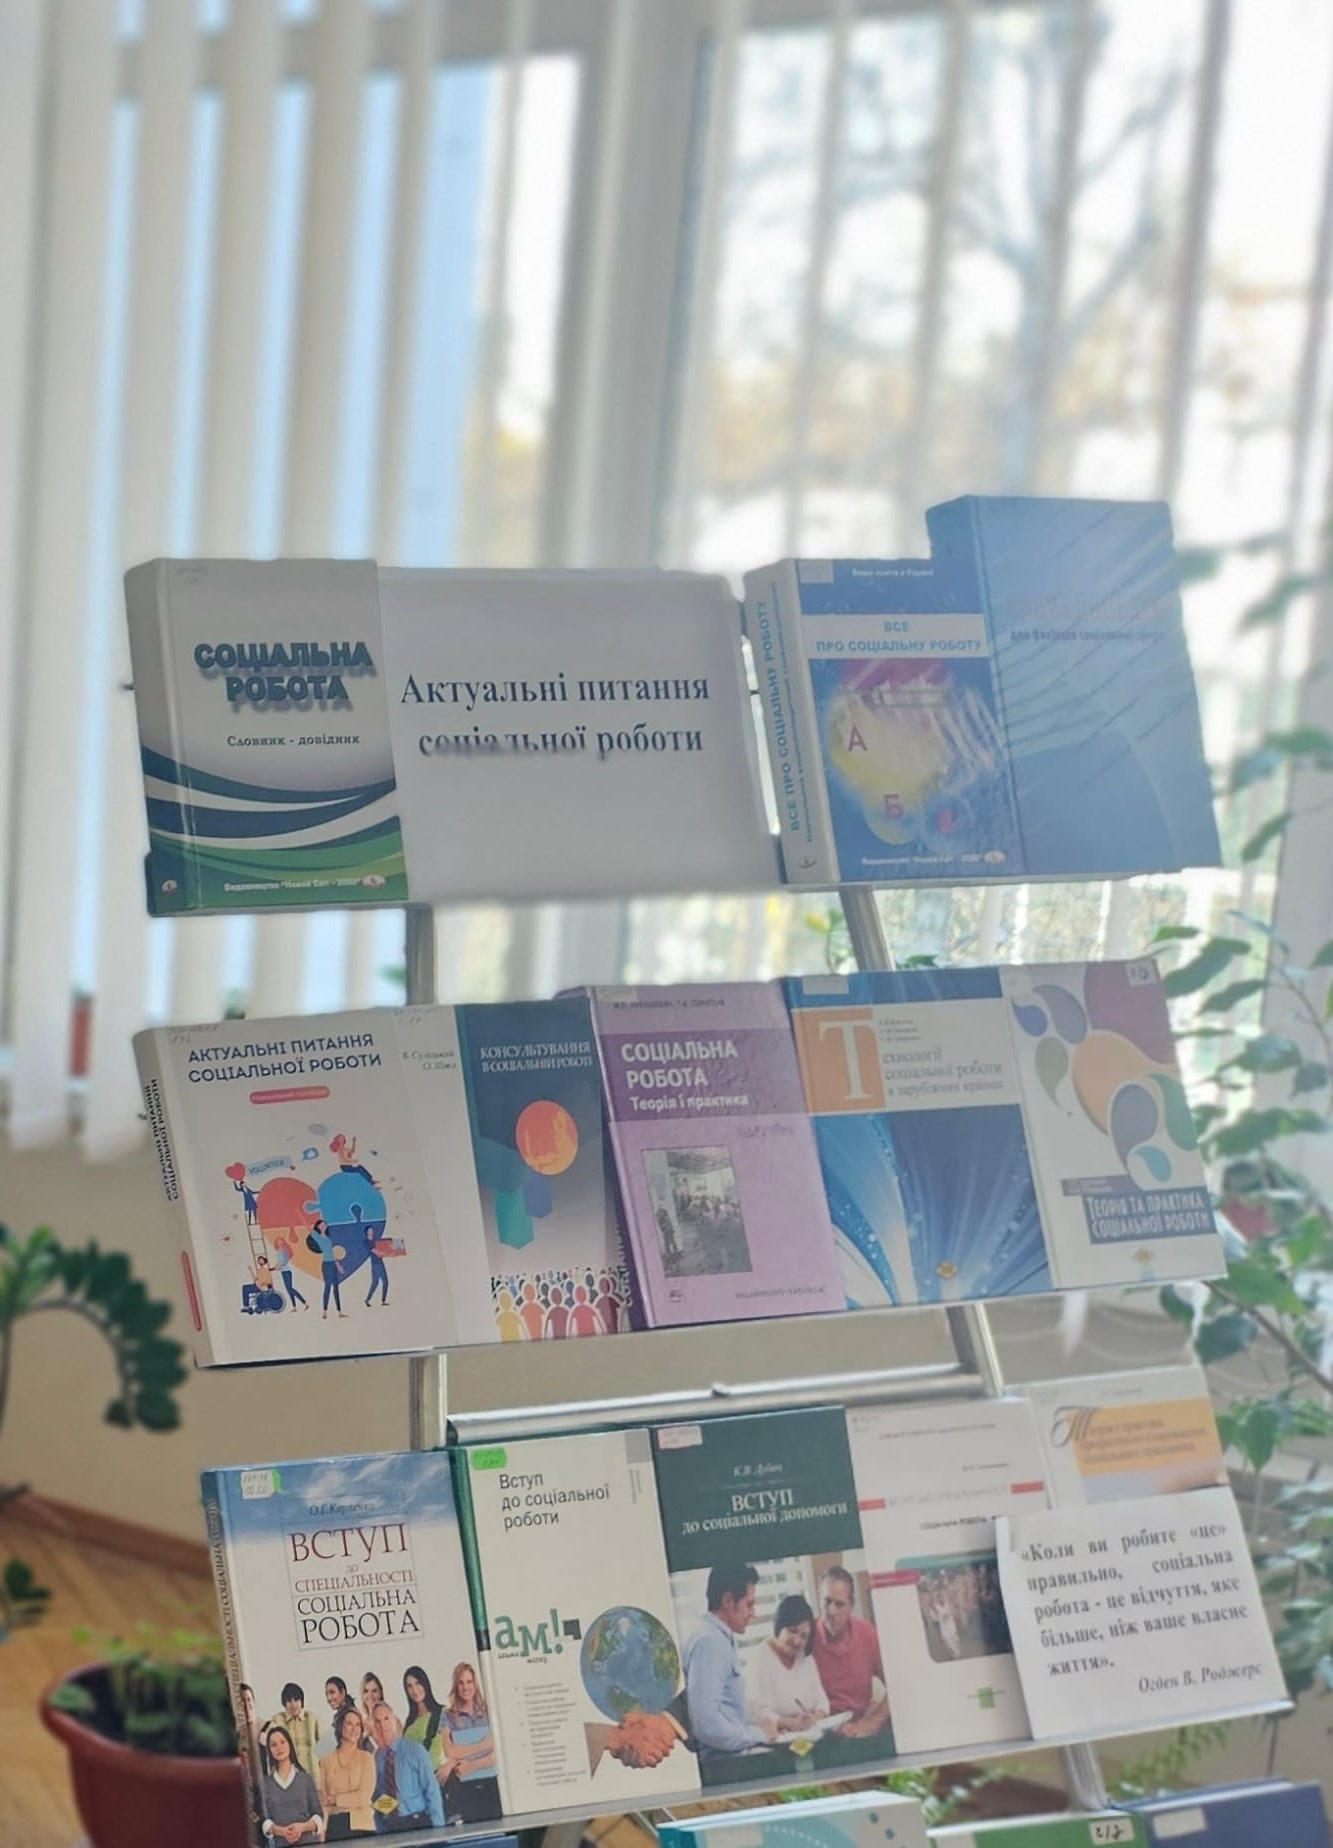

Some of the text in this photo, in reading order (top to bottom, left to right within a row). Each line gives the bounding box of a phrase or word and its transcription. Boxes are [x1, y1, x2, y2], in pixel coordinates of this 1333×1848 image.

[884, 622, 910, 633] ВСЕ
[194, 641, 373, 673] СОЦІАЛЬНА
[816, 639, 981, 655] ПРО СОЦІАЛЬНУ РОБОТУ
[225, 675, 350, 704] РОБОТА
[401, 673, 710, 711] Актуальні питання
[756, 600, 800, 831] ВСЕ ПРО СОЦІАЛЬНУ РОБОТУ
[227, 734, 285, 748] Словник
[298, 732, 360, 747] довідник
[419, 724, 704, 762] соціальної роботи
[188, 1033, 374, 1063] АКТУАЛЬНІ ПИТАННЯ
[481, 1041, 591, 1059] КОНСУЛЬТУВАННЯ
[621, 1040, 738, 1064] СОЦІАЛЬНА
[188, 1053, 382, 1084] СОЦІАЛЬНОЇ РОБОТИ
[490, 1057, 555, 1073] СОЦІАЛЬНІЙ
[556, 1056, 593, 1070] РОБОТІ
[626, 1067, 708, 1089] РОБОТА
[884, 1059, 1002, 1081] соціальної роботи
[630, 1095, 676, 1112] Теорія
[686, 1094, 749, 1112] практика
[1086, 1192, 1206, 1220] ТЕОРІЯ ТА ПРАКТИКА
[1091, 1211, 1212, 1239] СОЦІАЛЬНОЇ РОБОТИ
[499, 1473, 544, 1491] Вступ
[502, 1482, 610, 1512] до соціальної
[731, 1488, 793, 1513] ВСТУП
[504, 1511, 560, 1533] роботи
[682, 1501, 849, 1536] до соціальної допомоги
[289, 1523, 409, 1563] ВСТУП
[1021, 1523, 1227, 1563] «Коли ви робите «це»
[295, 1570, 414, 1594] СПЕЦІАЛЬНОСТІ
[1027, 1548, 1234, 1595] правильно, соціальна
[298, 1588, 417, 1616] СОЦІАЛЬНА
[1034, 1598, 1090, 1624] робота
[1106, 1596, 1126, 1611] це
[1130, 1580, 1208, 1607] відчуття,
[1211, 1575, 1240, 1594] яке
[301, 1609, 420, 1645] РОБОТА
[494, 1608, 564, 1658] ам!
[1040, 1605, 1249, 1649] більше, ніж ваше власне
[1046, 1654, 1116, 1677] життя».
[1138, 1671, 1180, 1693] Огден
[1201, 1661, 1263, 1687] Роджерс
